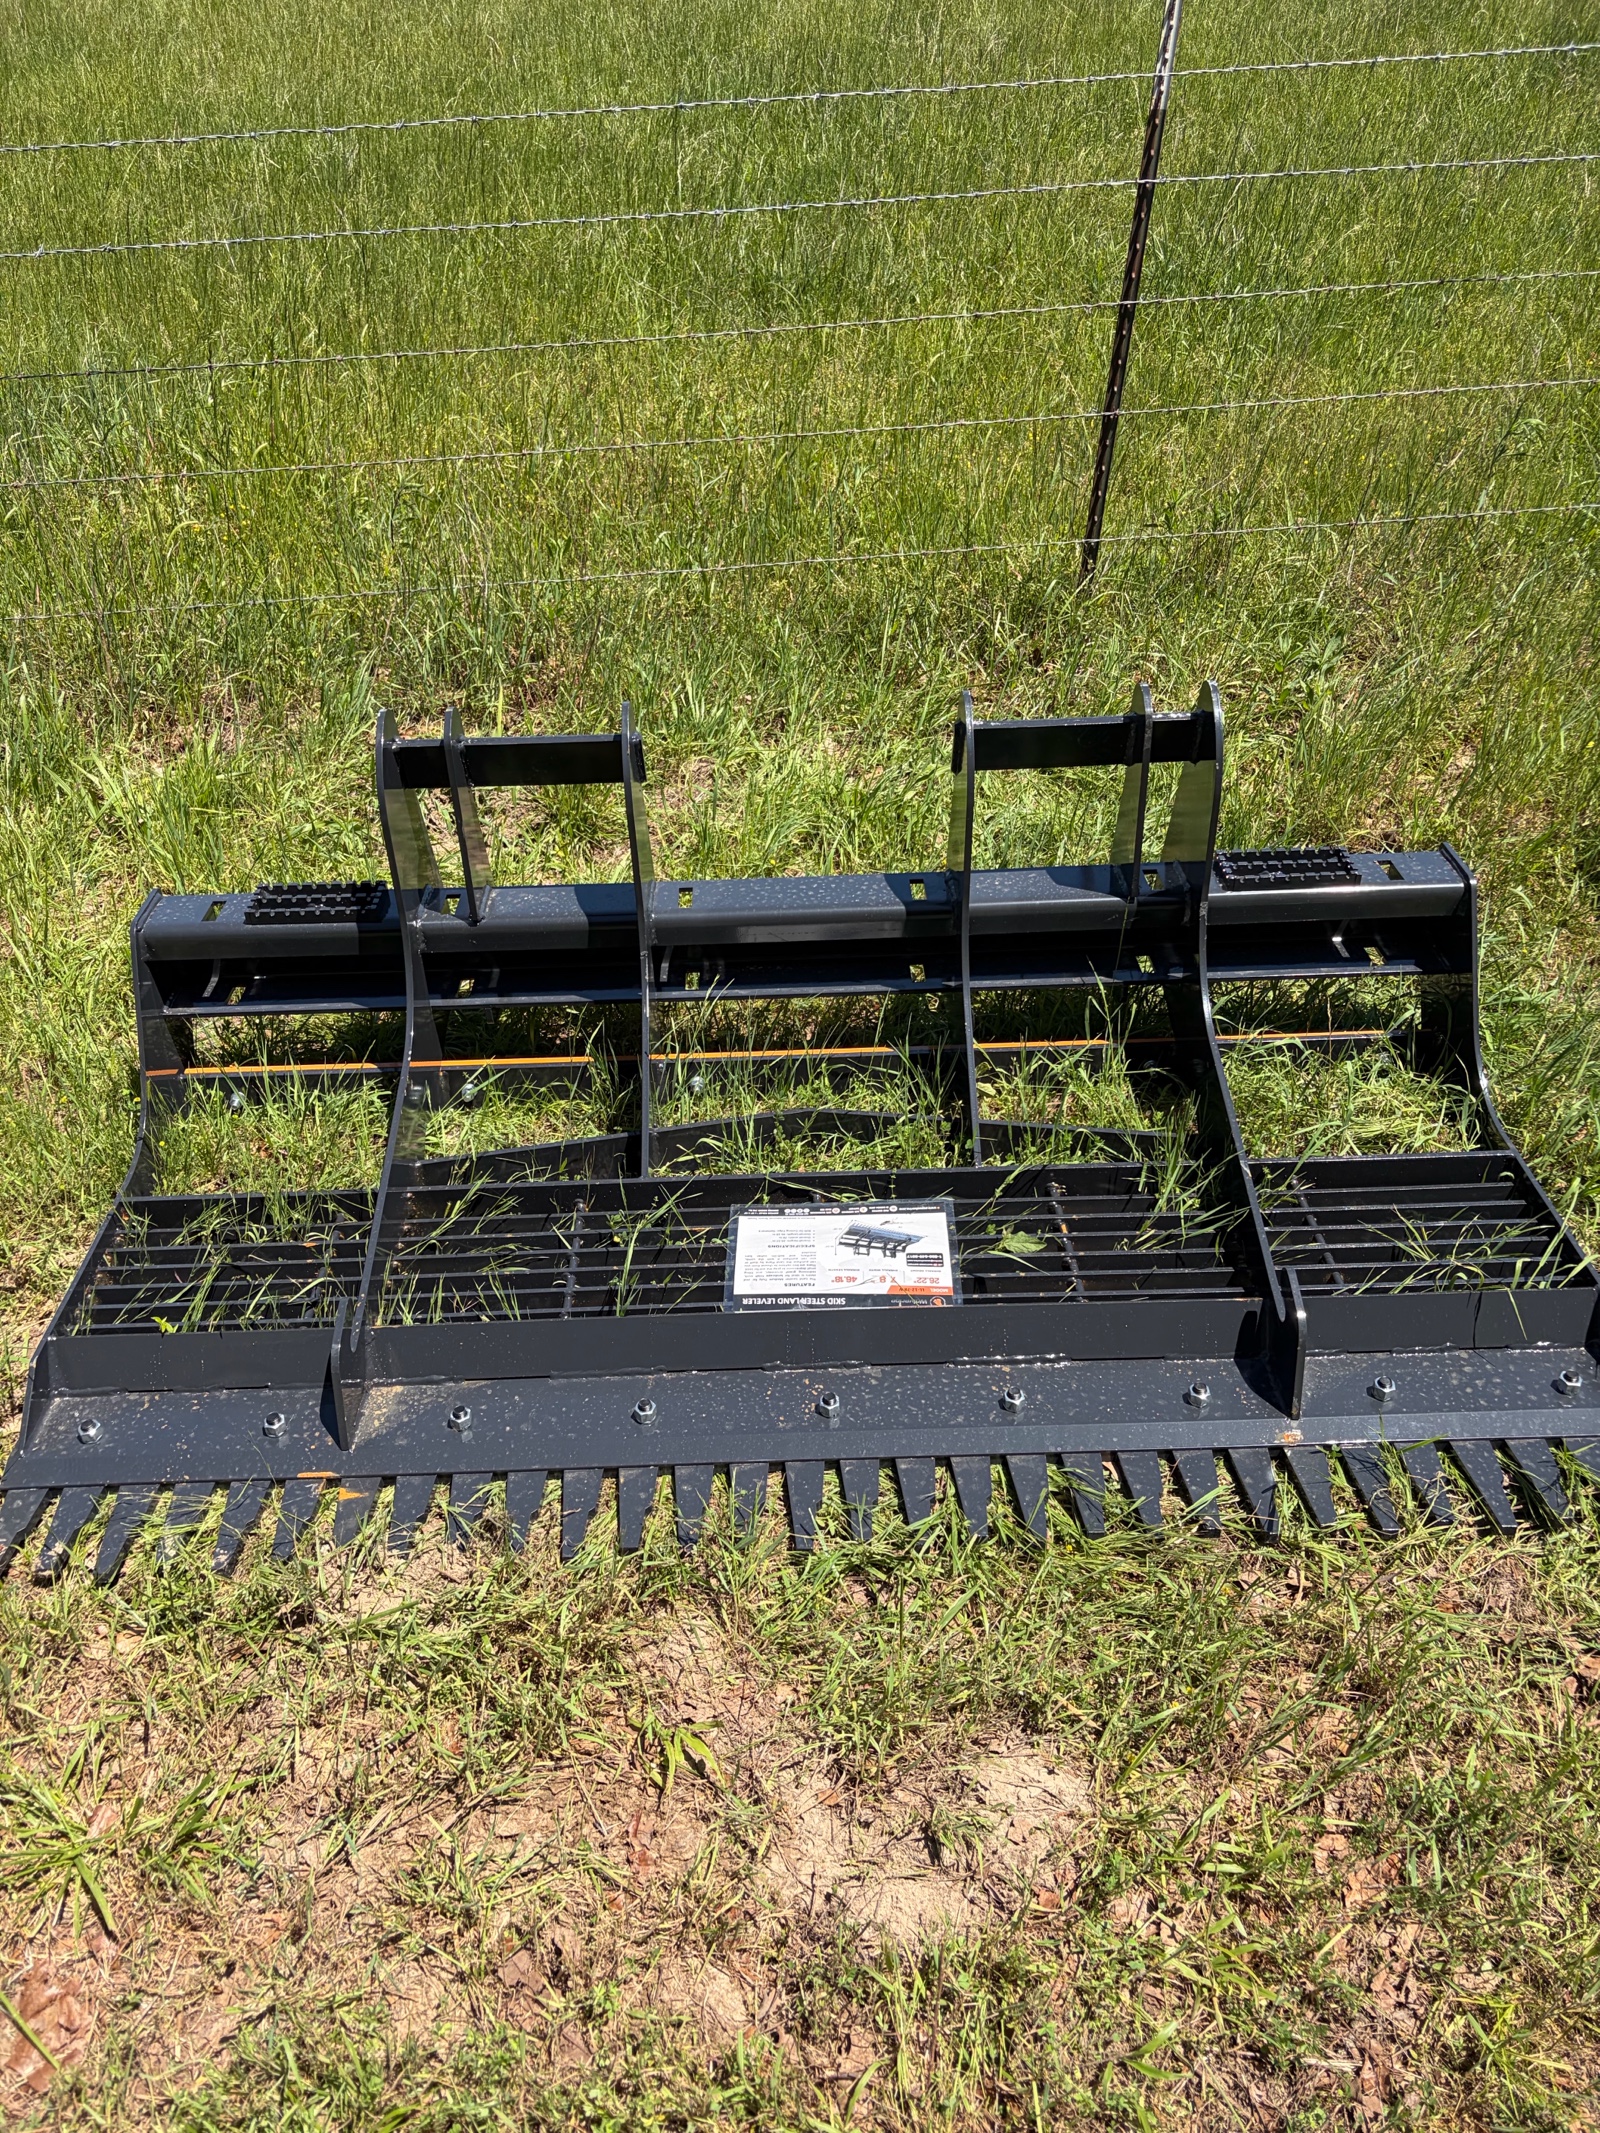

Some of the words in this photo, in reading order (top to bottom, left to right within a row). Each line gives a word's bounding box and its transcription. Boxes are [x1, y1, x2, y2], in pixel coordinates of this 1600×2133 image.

[777, 1297, 799, 1305] LAND
[800, 1297, 825, 1305] STEER
[827, 1297, 846, 1305] SKID
